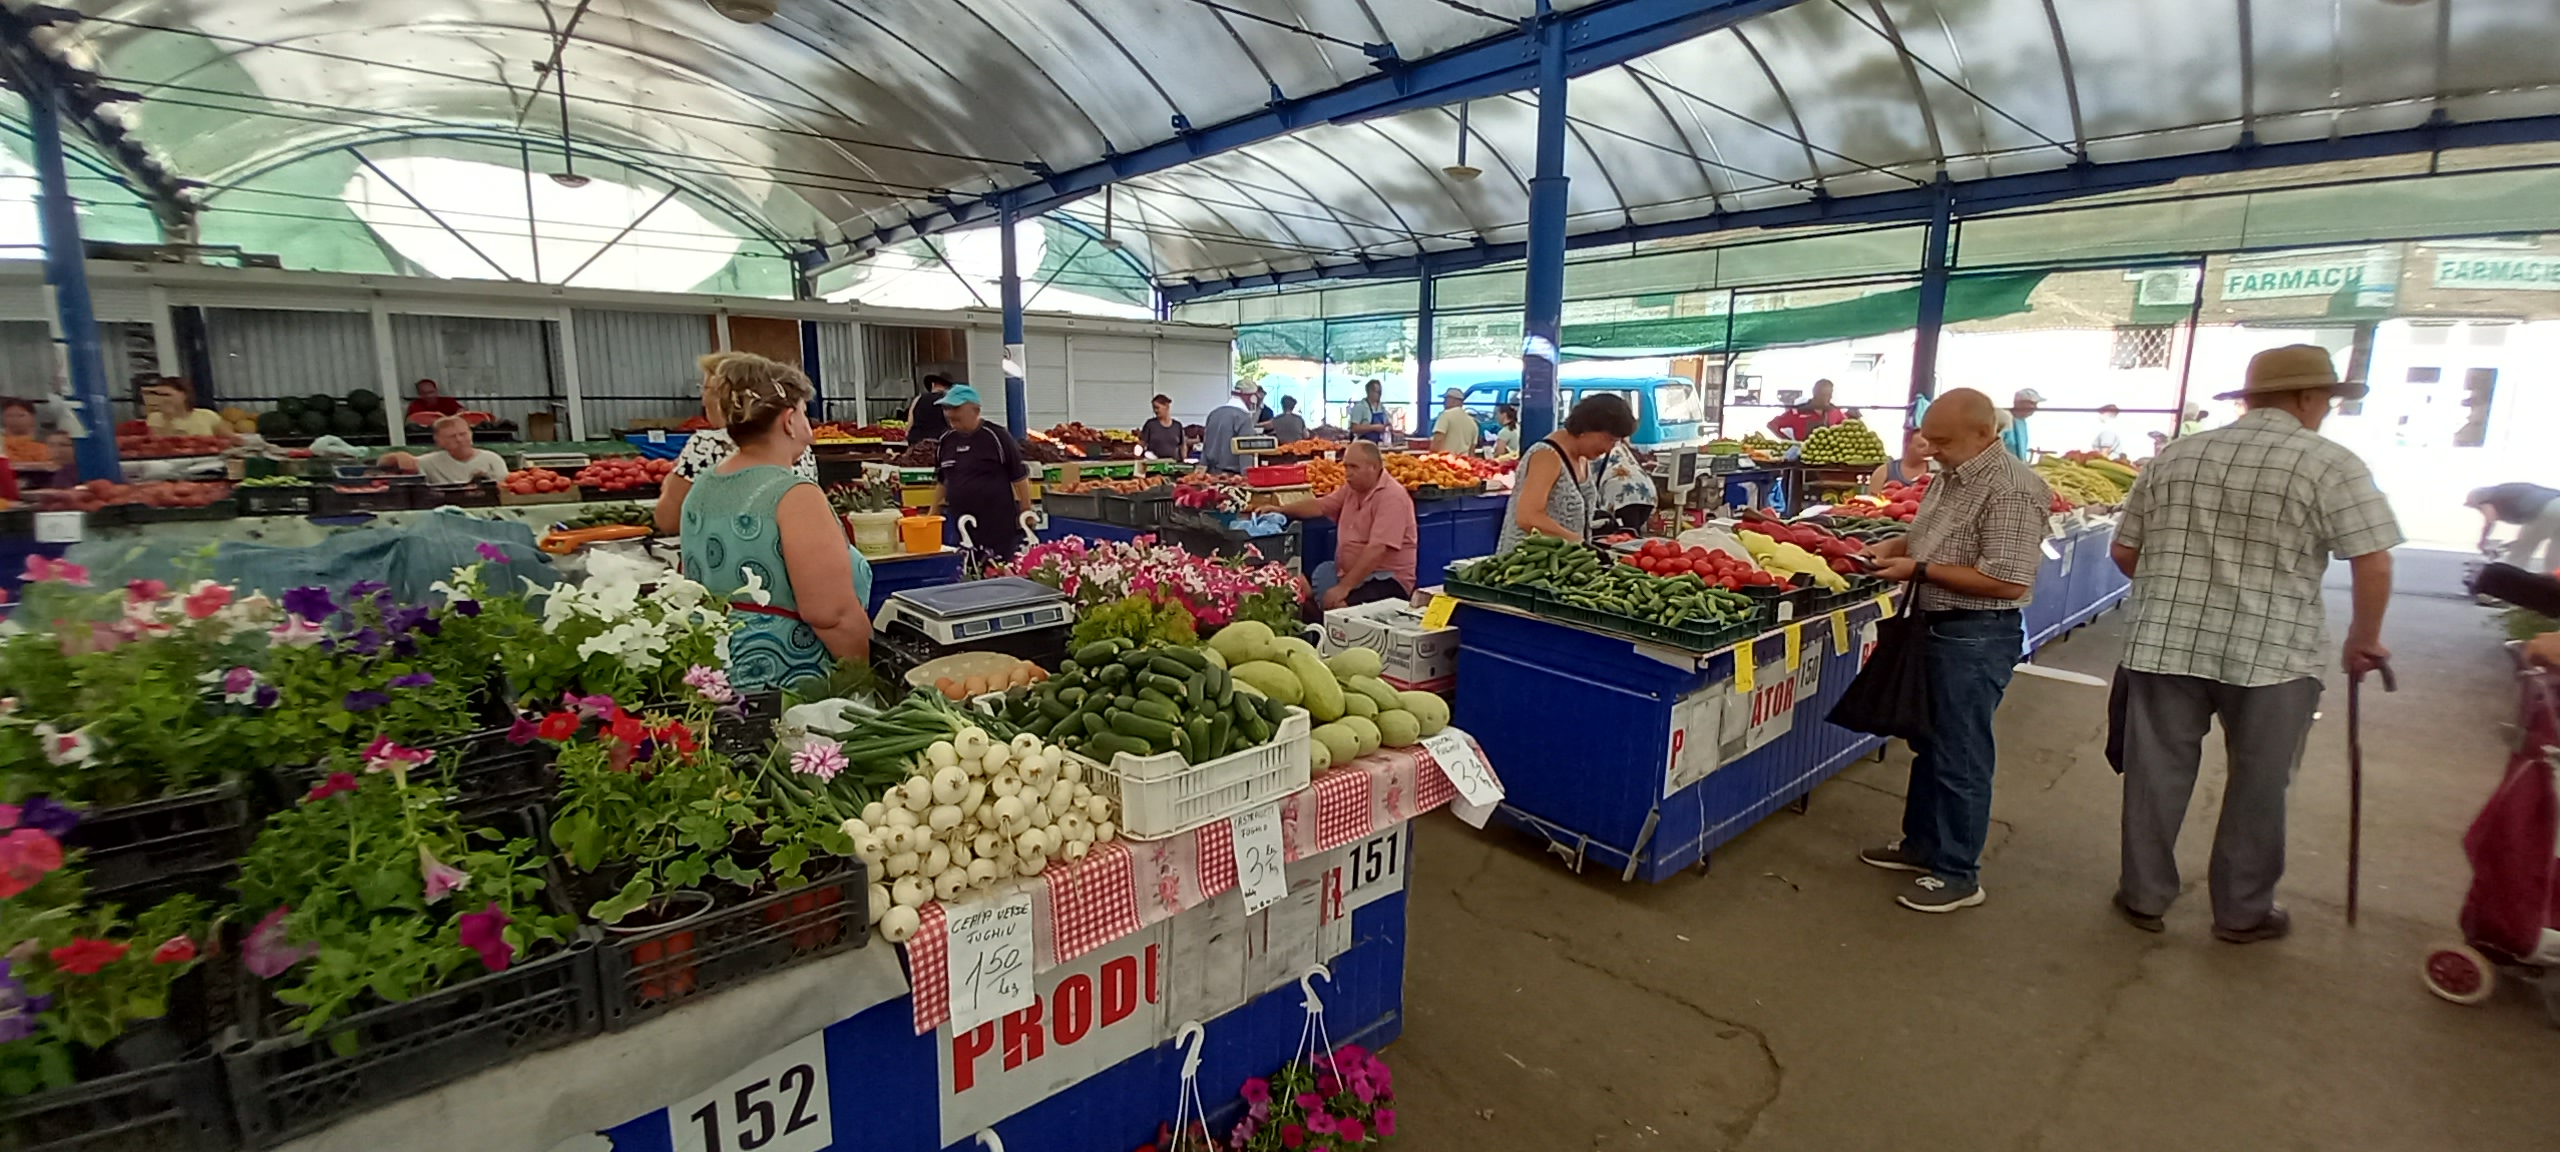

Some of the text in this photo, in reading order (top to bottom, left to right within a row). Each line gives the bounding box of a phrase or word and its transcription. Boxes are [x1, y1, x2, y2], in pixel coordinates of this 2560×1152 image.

[1799, 655, 1819, 688] 150
[1245, 846, 1264, 887] 3
[1349, 831, 1398, 892] 151
[997, 903, 1031, 921] VERDE
[690, 1063, 818, 1152] 152
